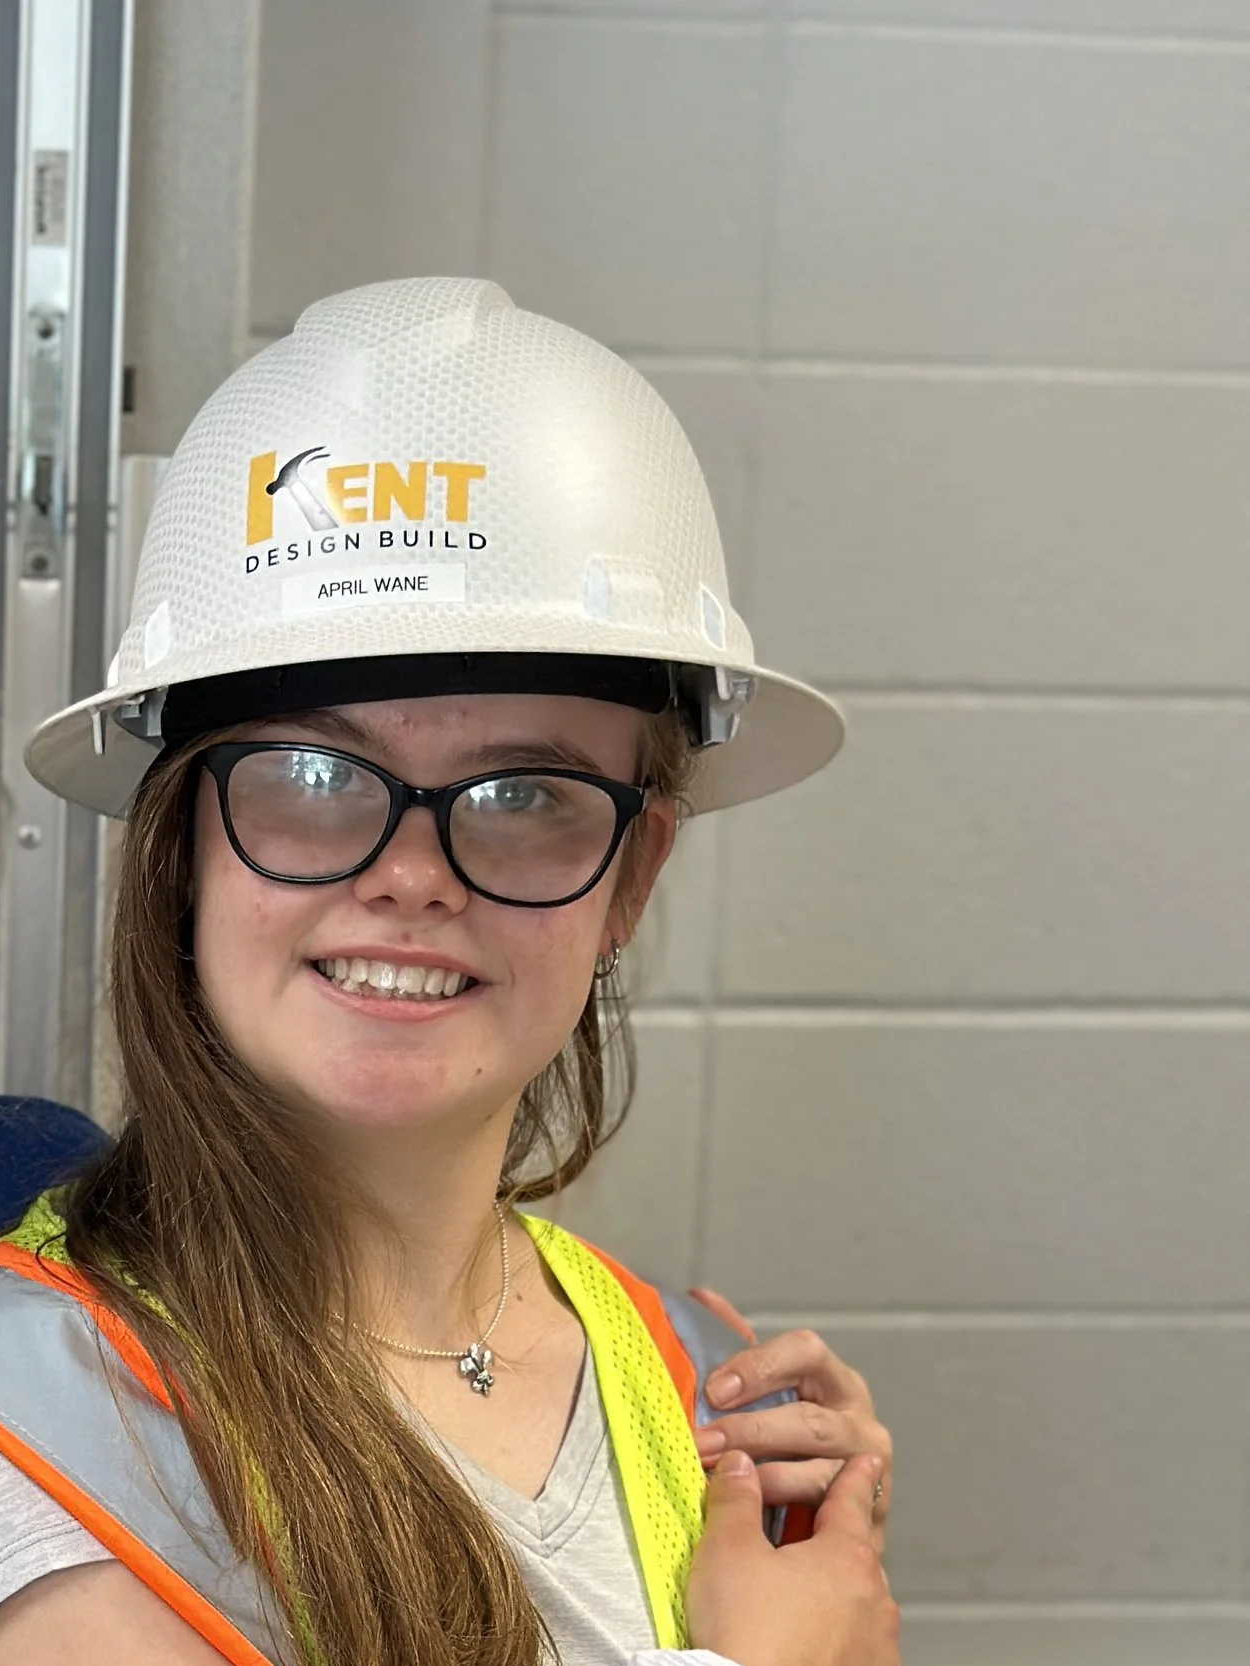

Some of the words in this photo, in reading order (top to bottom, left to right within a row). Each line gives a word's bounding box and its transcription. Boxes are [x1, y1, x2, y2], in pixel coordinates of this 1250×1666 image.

[246, 446, 486, 545] KENT
[246, 532, 361, 574] DESIGN
[379, 530, 488, 550] BUILD
[317, 579, 368, 599] APRIL
[374, 575, 429, 593] WANE
